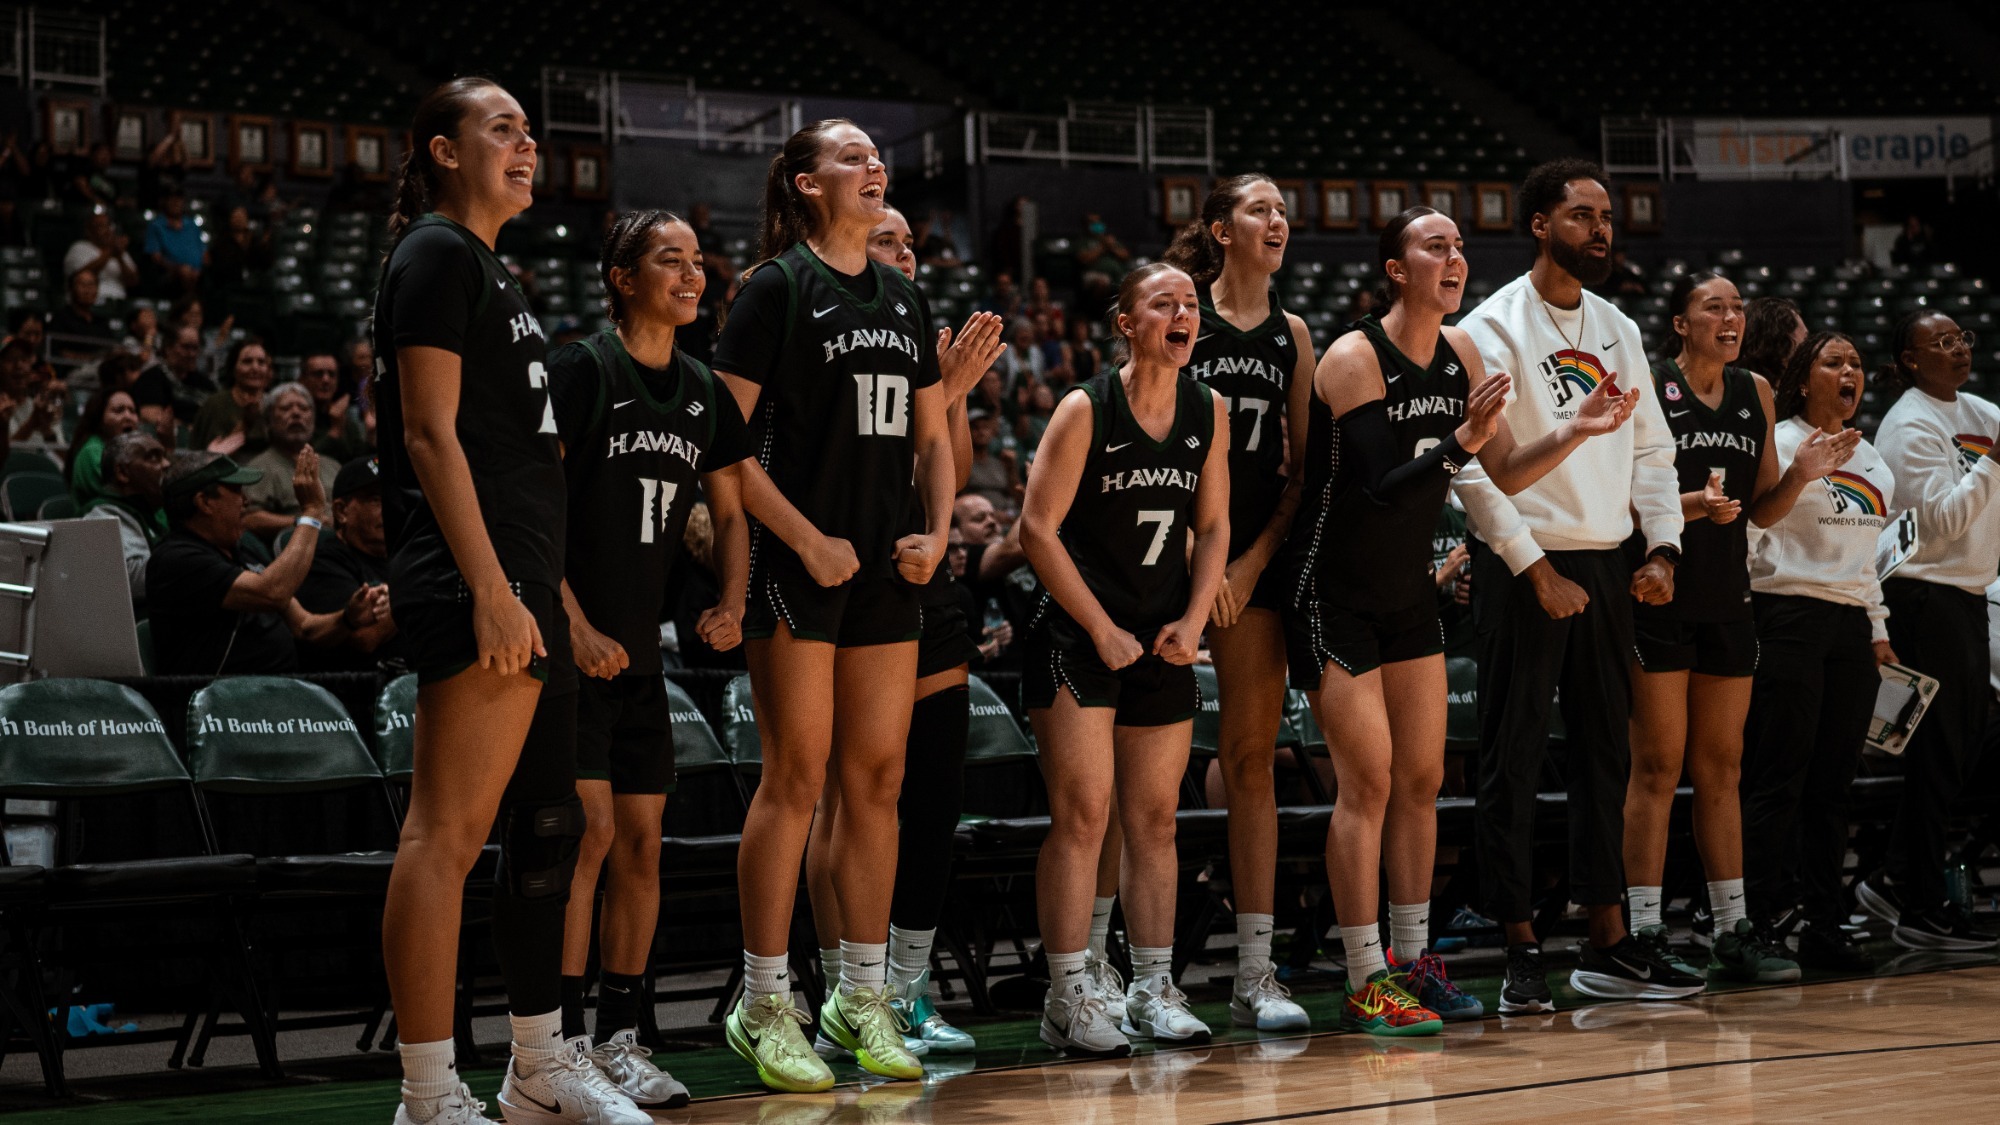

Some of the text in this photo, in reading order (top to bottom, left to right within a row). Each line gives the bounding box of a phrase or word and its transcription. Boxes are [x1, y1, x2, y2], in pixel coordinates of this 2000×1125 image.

[853, 373, 909, 437] 10
[638, 477, 678, 544] 11
[1817, 517, 1856, 526] WOMEN'S
[1136, 509, 1175, 566] 7
[23, 720, 75, 736] Bank
[77, 720, 98, 736] of
[100, 718, 165, 736] Hawaii
[227, 718, 275, 734] Bank
[276, 719, 295, 734] of
[299, 717, 358, 733] Hawaii
